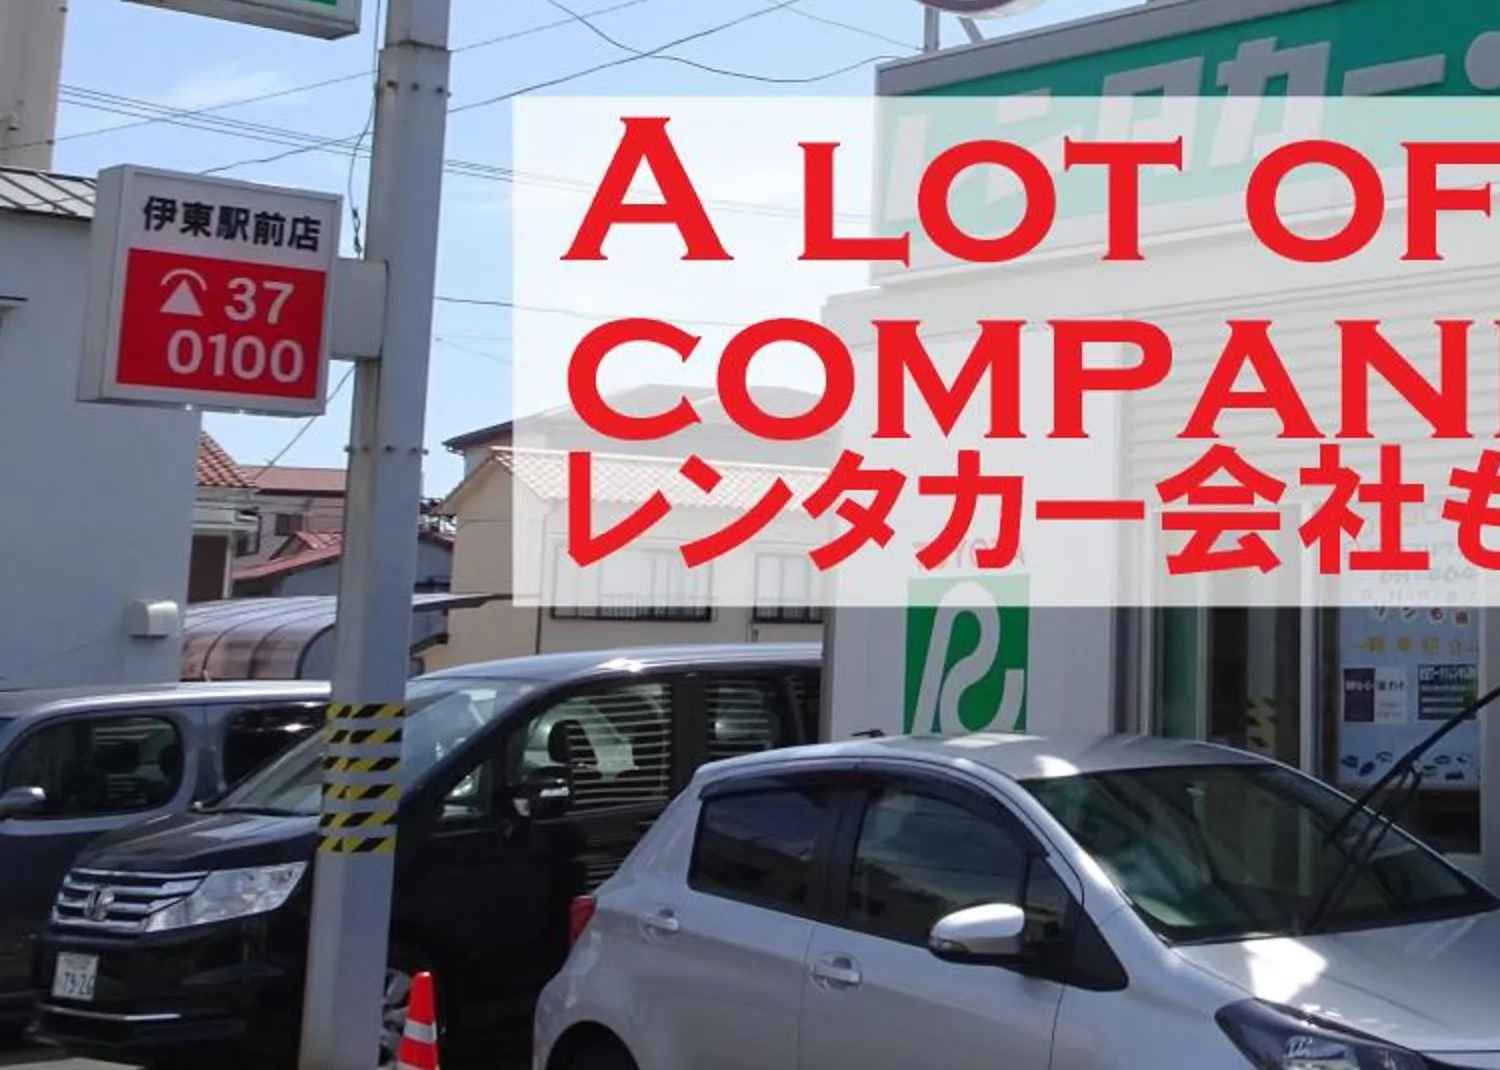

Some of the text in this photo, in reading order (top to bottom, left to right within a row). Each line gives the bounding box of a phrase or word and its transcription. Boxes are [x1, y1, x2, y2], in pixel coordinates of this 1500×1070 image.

[143, 196, 322, 252] 伊東駅前店
[223, 277, 294, 325] 37
[166, 329, 305, 383] 0100
